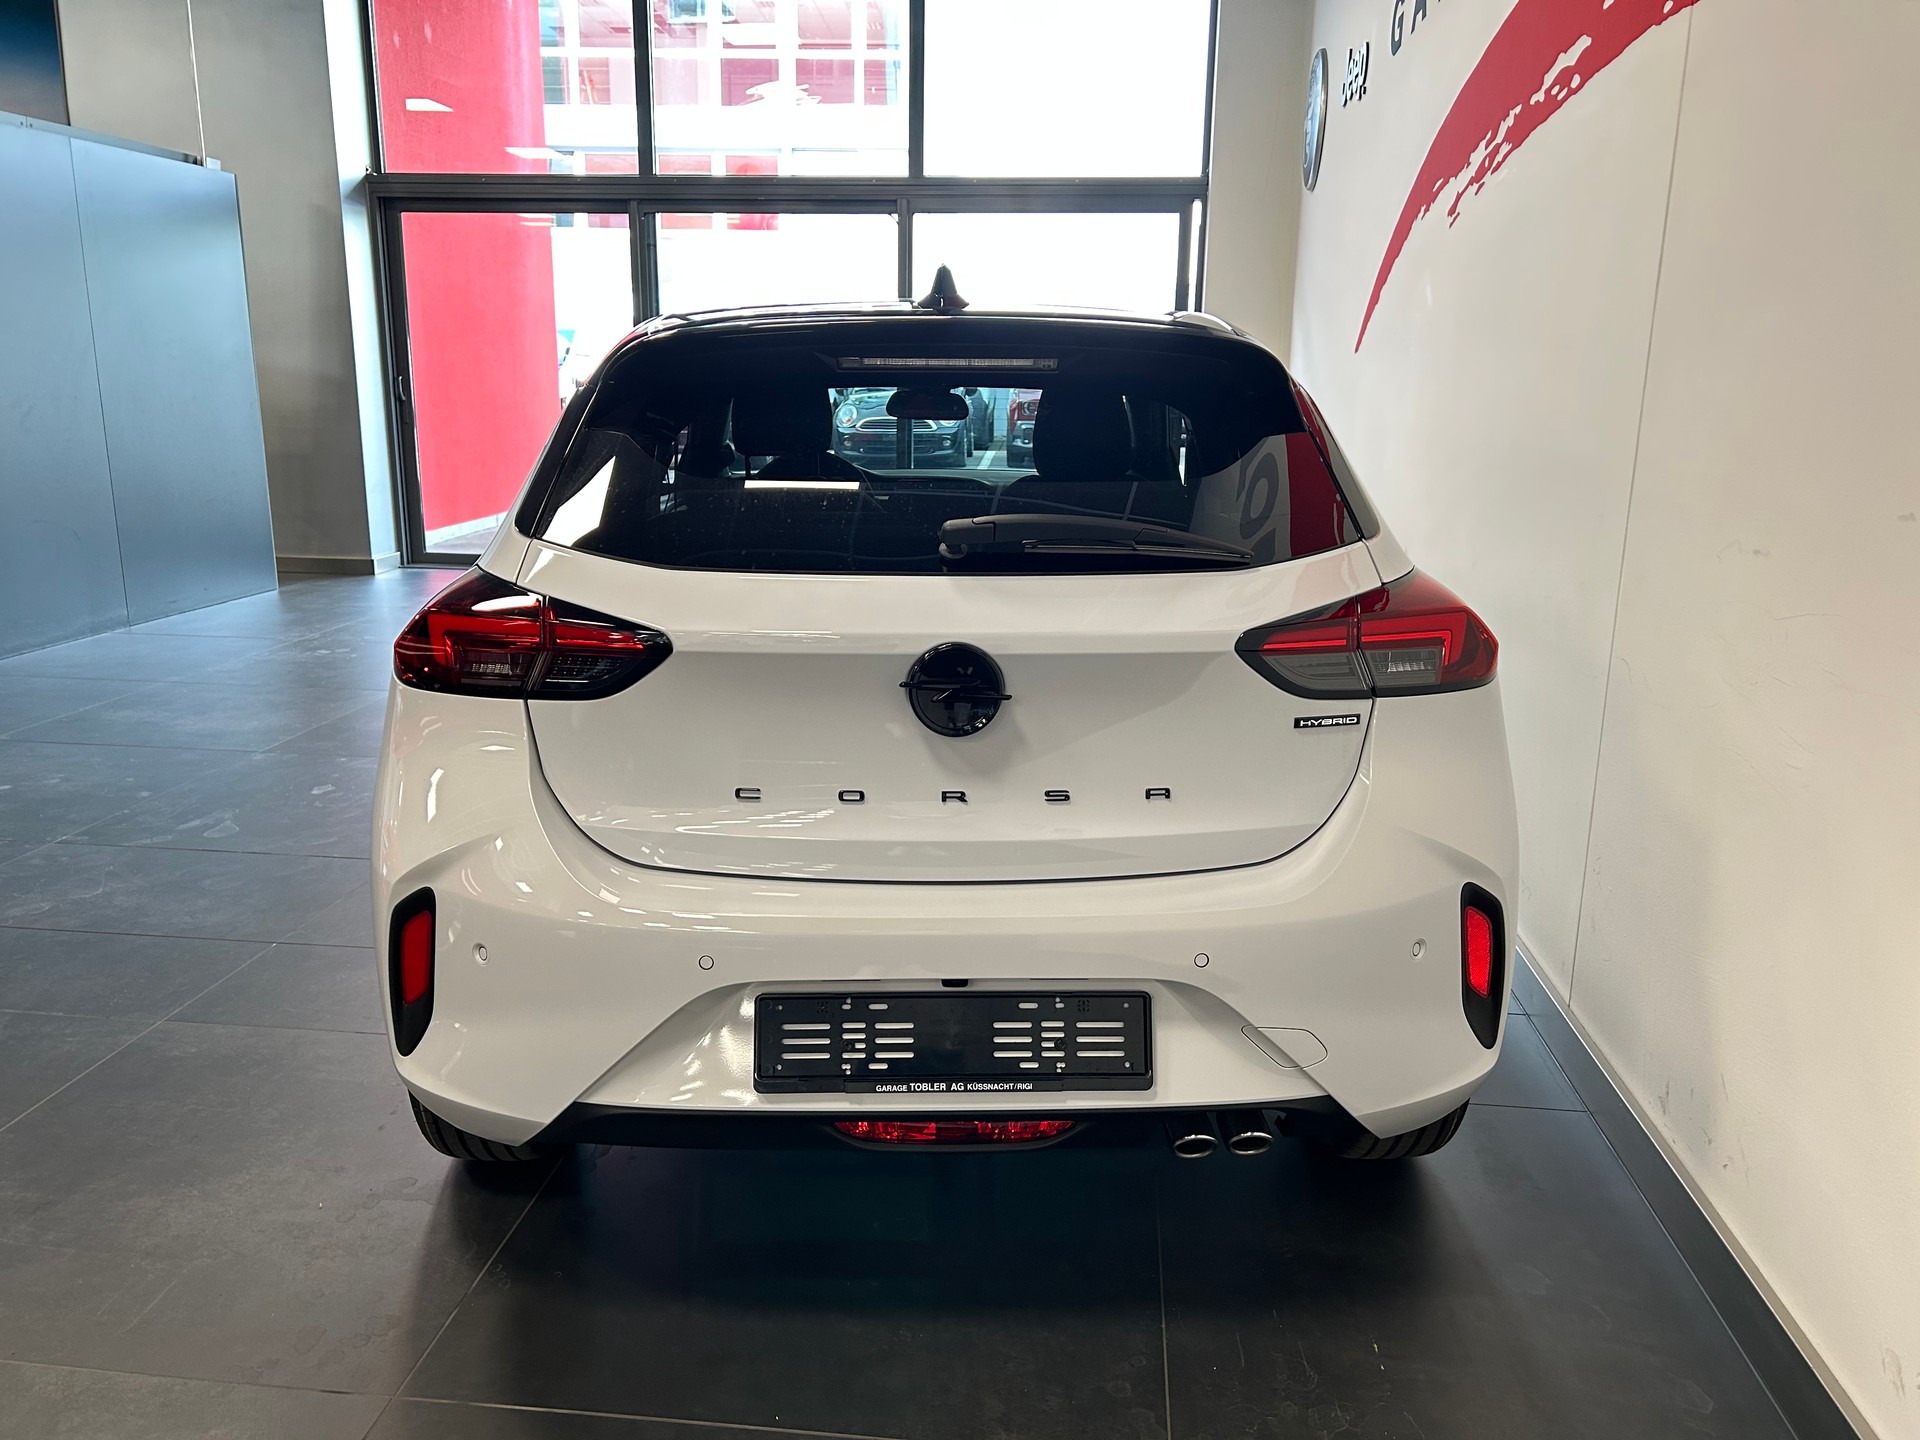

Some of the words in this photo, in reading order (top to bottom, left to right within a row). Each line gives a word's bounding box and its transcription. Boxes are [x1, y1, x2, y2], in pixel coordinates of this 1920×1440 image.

[1391, 0, 1440, 56] GA
[1342, 41, 1369, 107] Jeep
[1299, 716, 1358, 727] HYBRID
[734, 786, 1171, 803] CORSA
[875, 1084, 908, 1092] GARAGE
[909, 1083, 947, 1092] TOBLER
[950, 1082, 965, 1092] AG
[967, 1082, 1033, 1091] KÜSSNACHT/RIGI
